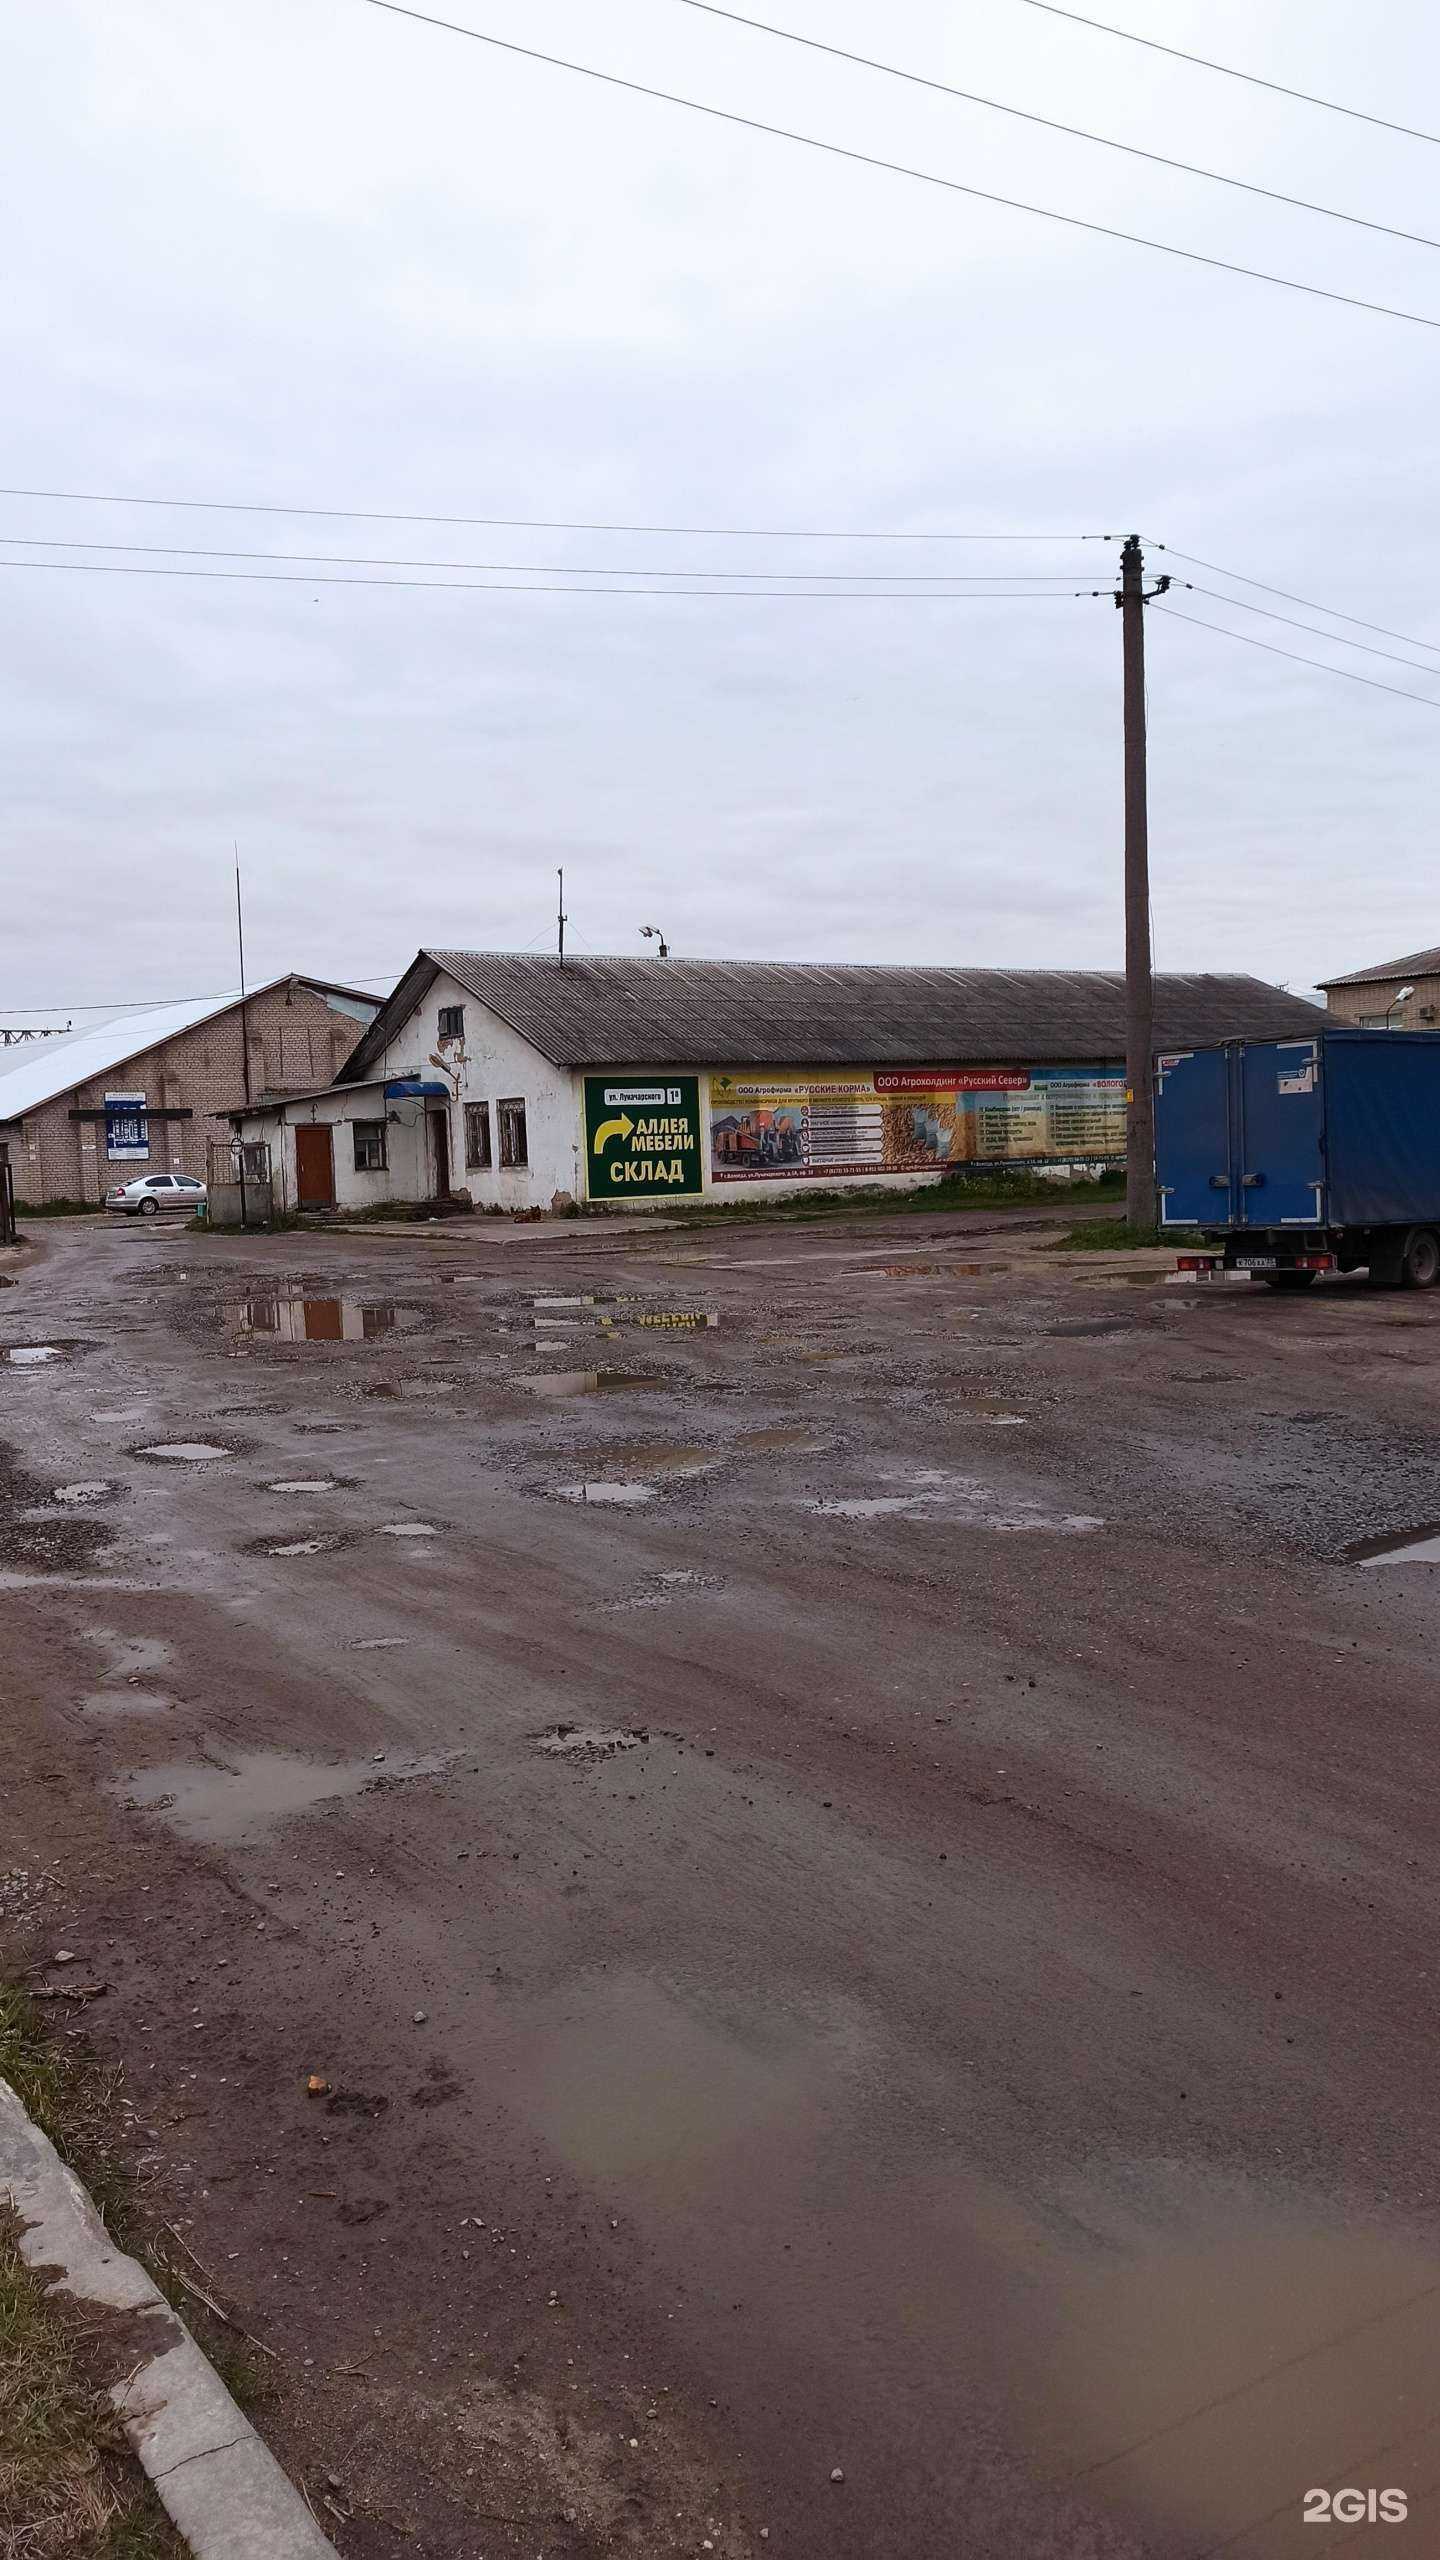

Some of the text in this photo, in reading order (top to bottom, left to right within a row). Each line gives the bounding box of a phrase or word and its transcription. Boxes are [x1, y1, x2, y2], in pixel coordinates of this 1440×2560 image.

[877, 1074, 1027, 1088] ООО Агрохолдинг «Русский Север»
[619, 1092, 662, 1101] Луначарского
[738, 1086, 754, 1094] ООО
[755, 1086, 792, 1094] Агрофирма
[794, 1084, 837, 1094] «РУССКИЕ
[838, 1084, 871, 1093] КОРМА»
[637, 1118, 688, 1134] АЛЛЕЯ
[631, 1135, 694, 1151] МЕБЕЛИ
[610, 1160, 684, 1183] СКЛАД
